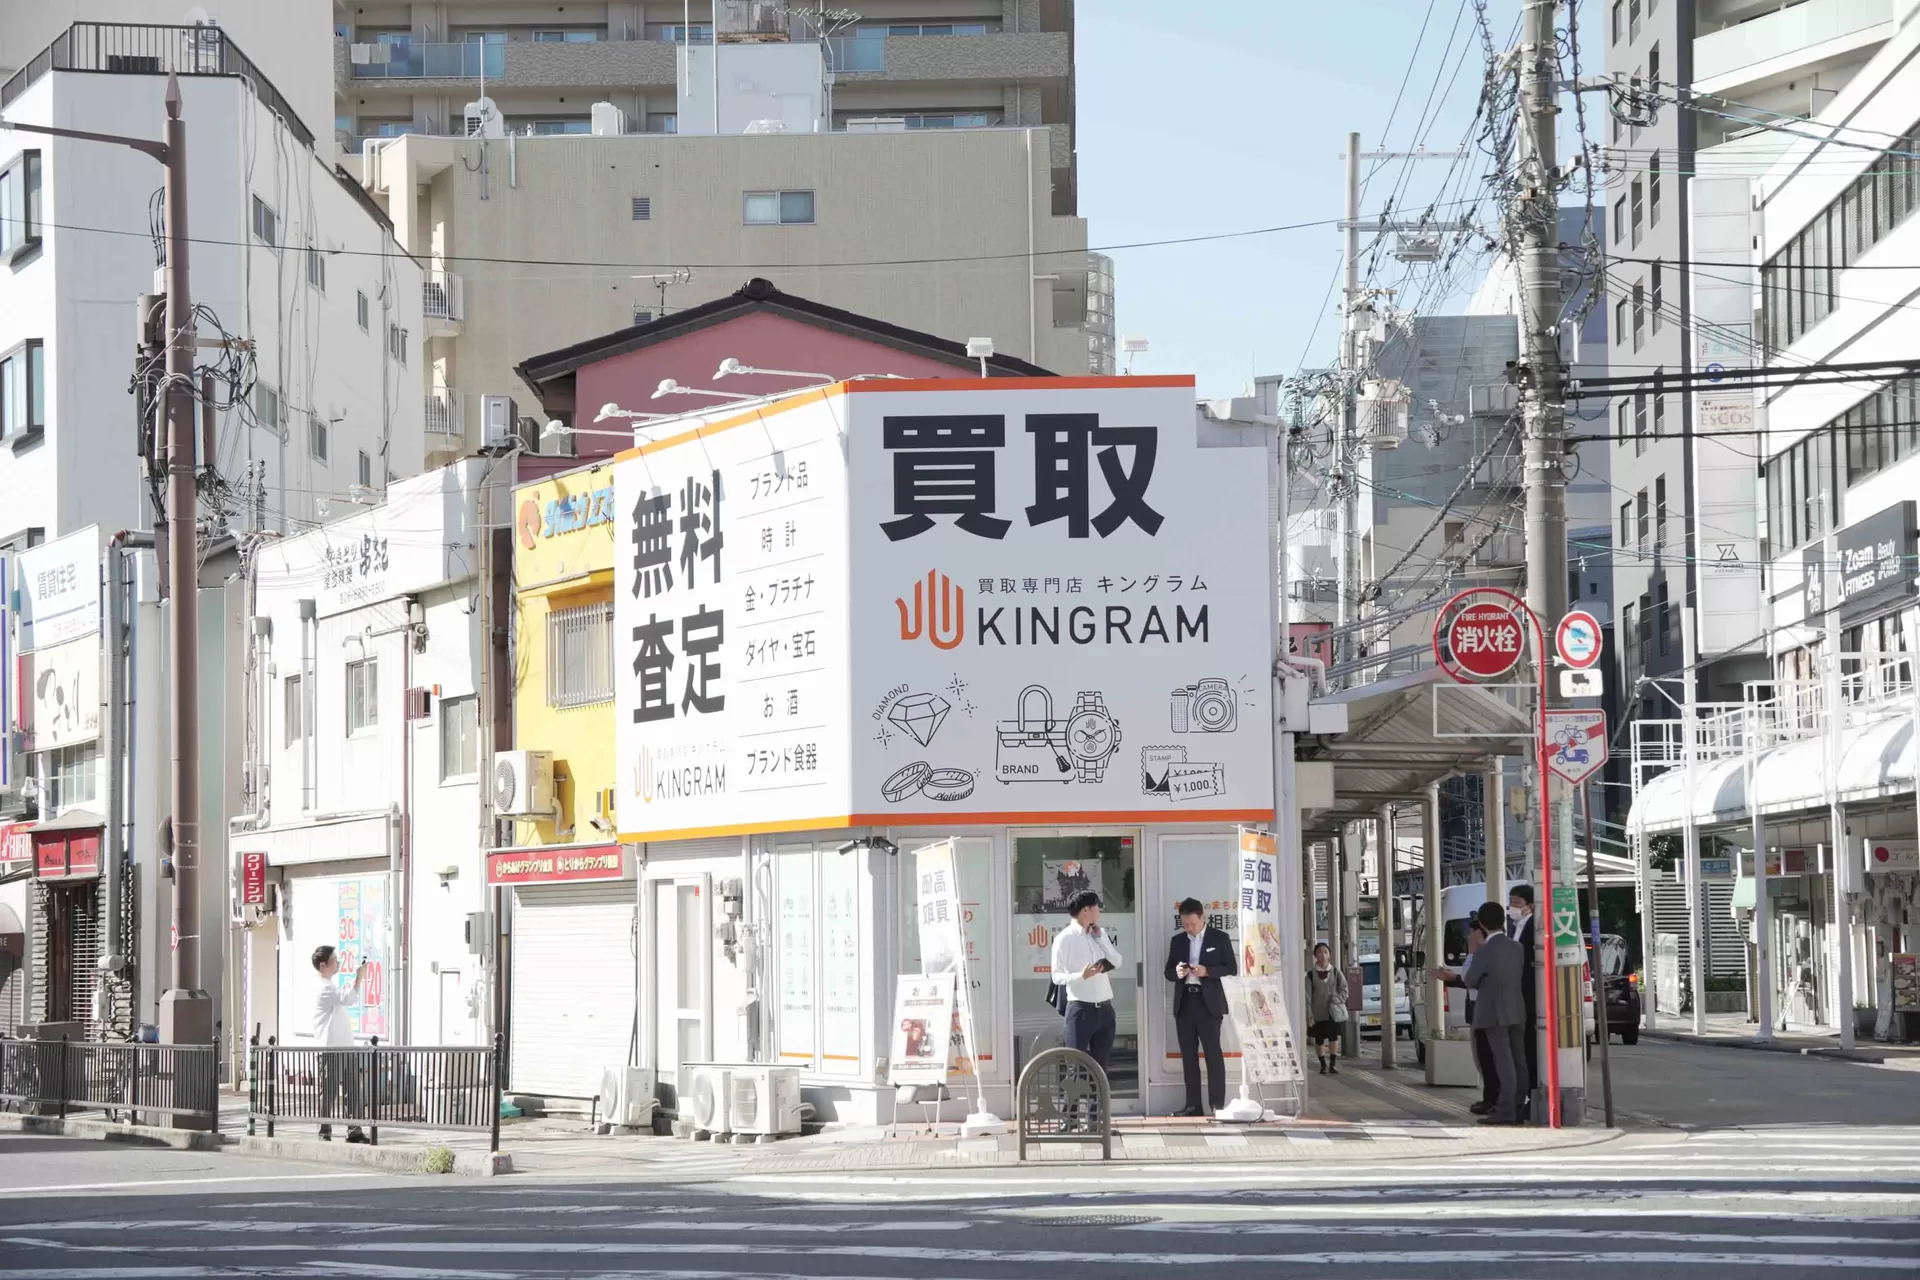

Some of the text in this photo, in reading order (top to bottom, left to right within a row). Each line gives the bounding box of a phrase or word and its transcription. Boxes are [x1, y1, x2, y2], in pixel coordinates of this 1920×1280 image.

[1700, 412, 1751, 426] ESCOS
[750, 461, 808, 500] ブランド品
[879, 413, 1165, 542] 買取
[631, 468, 724, 600] 無料
[762, 519, 797, 552] 時計
[38, 562, 76, 601] 賃貸住宅
[745, 573, 815, 612] 金・プラチナ
[978, 574, 1209, 595] 買取専門店 キングラム
[1845, 570, 1875, 597] FITNESS
[978, 604, 1209, 646] KINGRAM
[1461, 612, 1510, 622] FIRE HYDRANT
[745, 630, 816, 666] ダイヤ・宝石
[1456, 624, 1517, 653] 消火栓
[632, 603, 726, 724] 査定
[763, 688, 799, 719] お酒
[872, 683, 910, 721] DIAMOND
[1198, 683, 1228, 692] CAMERA
[747, 742, 818, 776] ブランド食器
[1002, 764, 1039, 774] BRAND
[656, 763, 726, 800] KINGRAM
[1243, 857, 1273, 884] 高価
[1242, 887, 1273, 914] 買取
